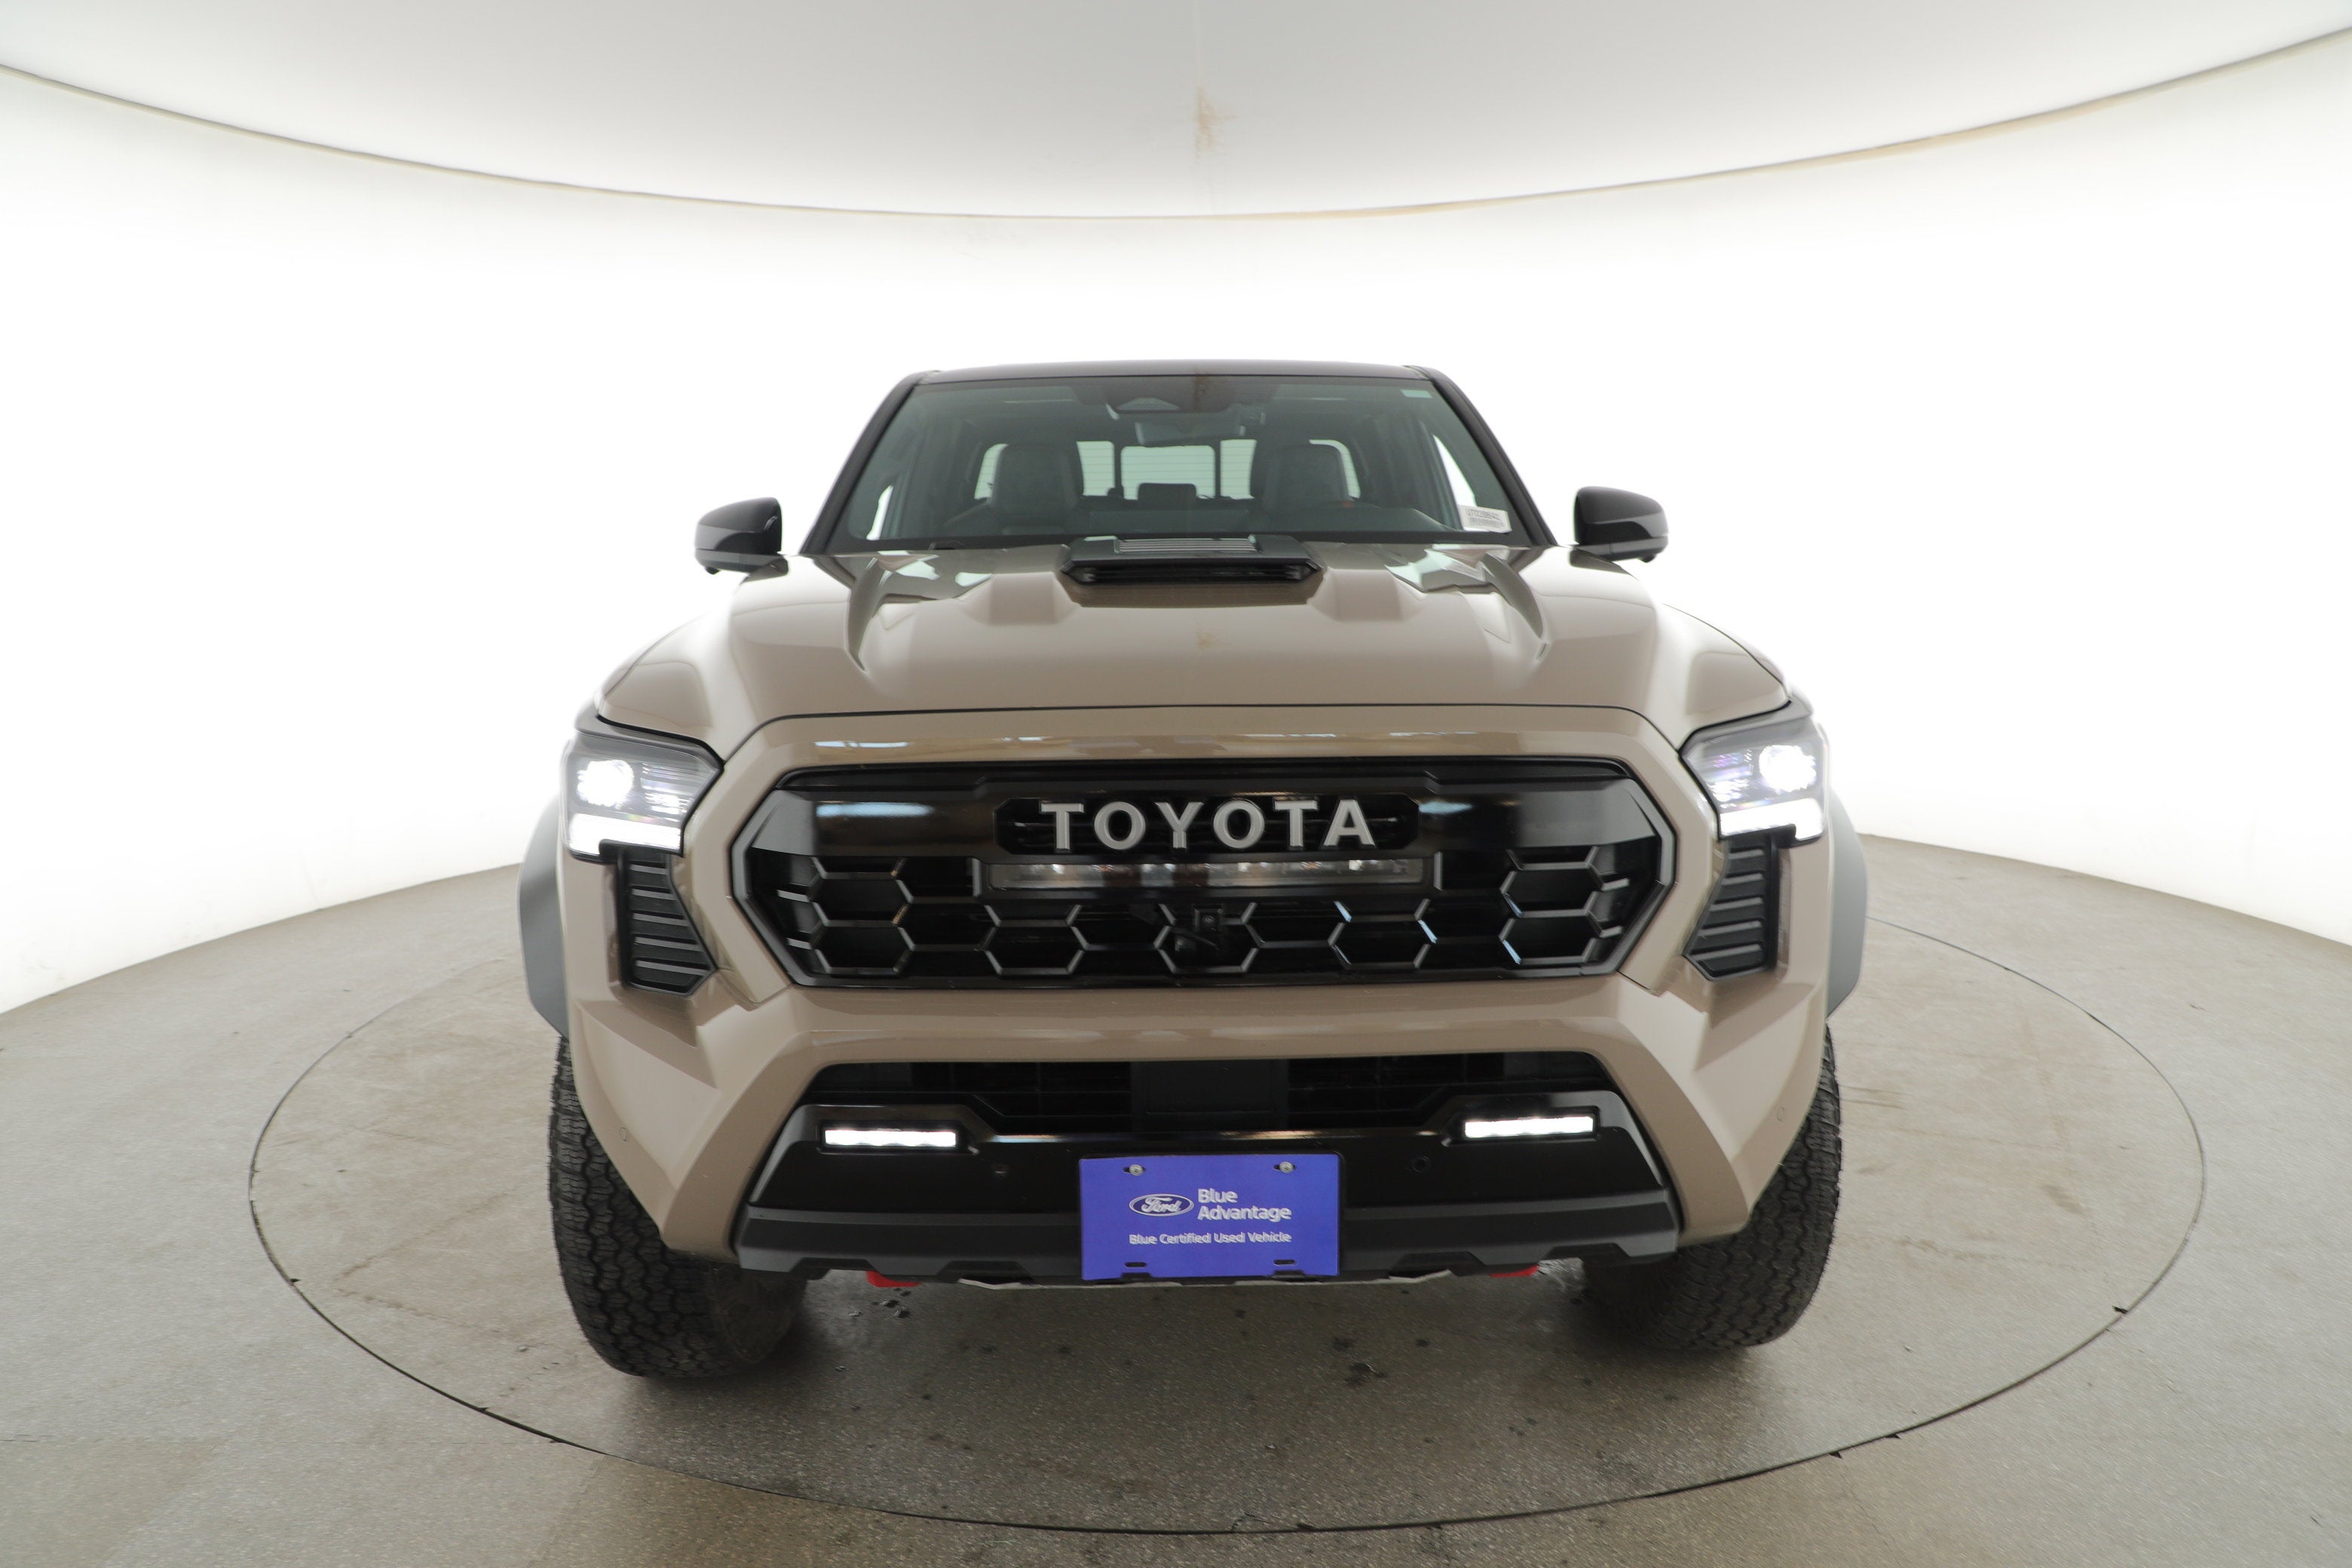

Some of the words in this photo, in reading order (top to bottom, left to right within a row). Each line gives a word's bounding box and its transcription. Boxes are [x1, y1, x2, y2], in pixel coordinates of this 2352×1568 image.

[1040, 799, 1374, 851] TOYOTA
[1197, 1188, 1238, 1203] Blue
[1141, 1196, 1182, 1213] Ford
[1197, 1205, 1292, 1222] Advantage
[1129, 1233, 1158, 1245] Blue
[1159, 1232, 1211, 1244] Certified
[1214, 1231, 1245, 1243] Used
[1248, 1231, 1292, 1242] Vehicle
